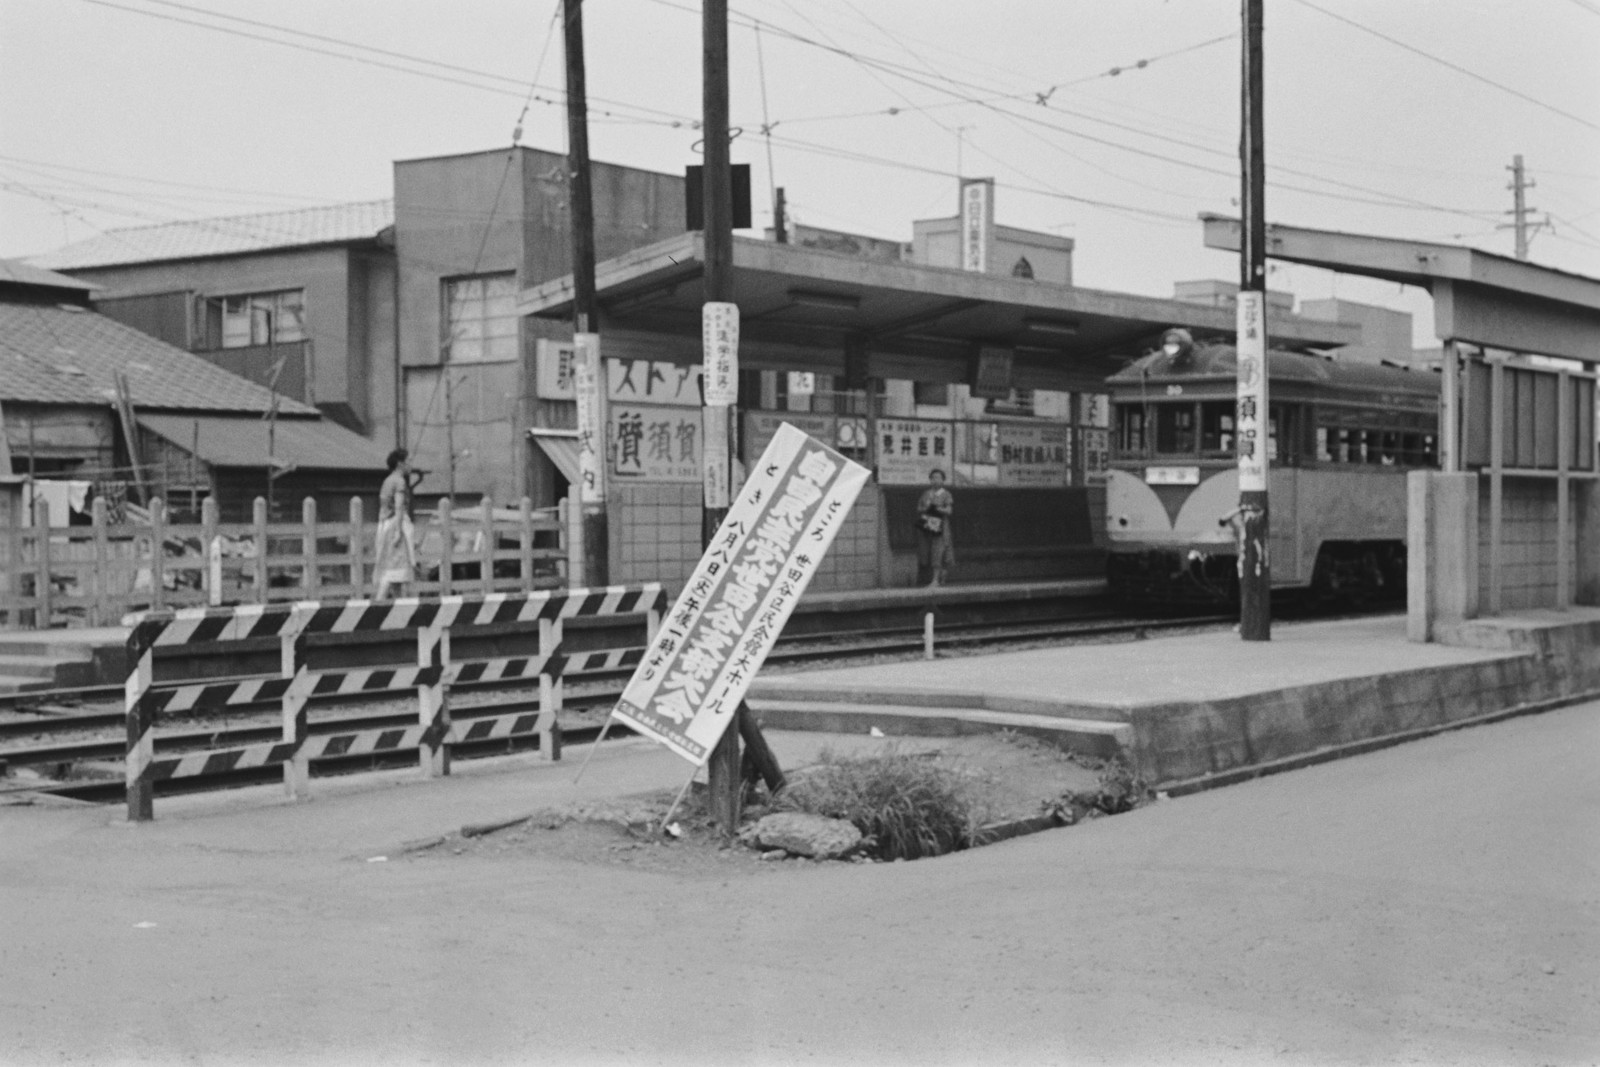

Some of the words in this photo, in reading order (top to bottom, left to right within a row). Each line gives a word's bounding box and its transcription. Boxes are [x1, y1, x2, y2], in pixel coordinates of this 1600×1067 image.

[654, 450, 837, 724] 自由民主党世田谷支部大会
